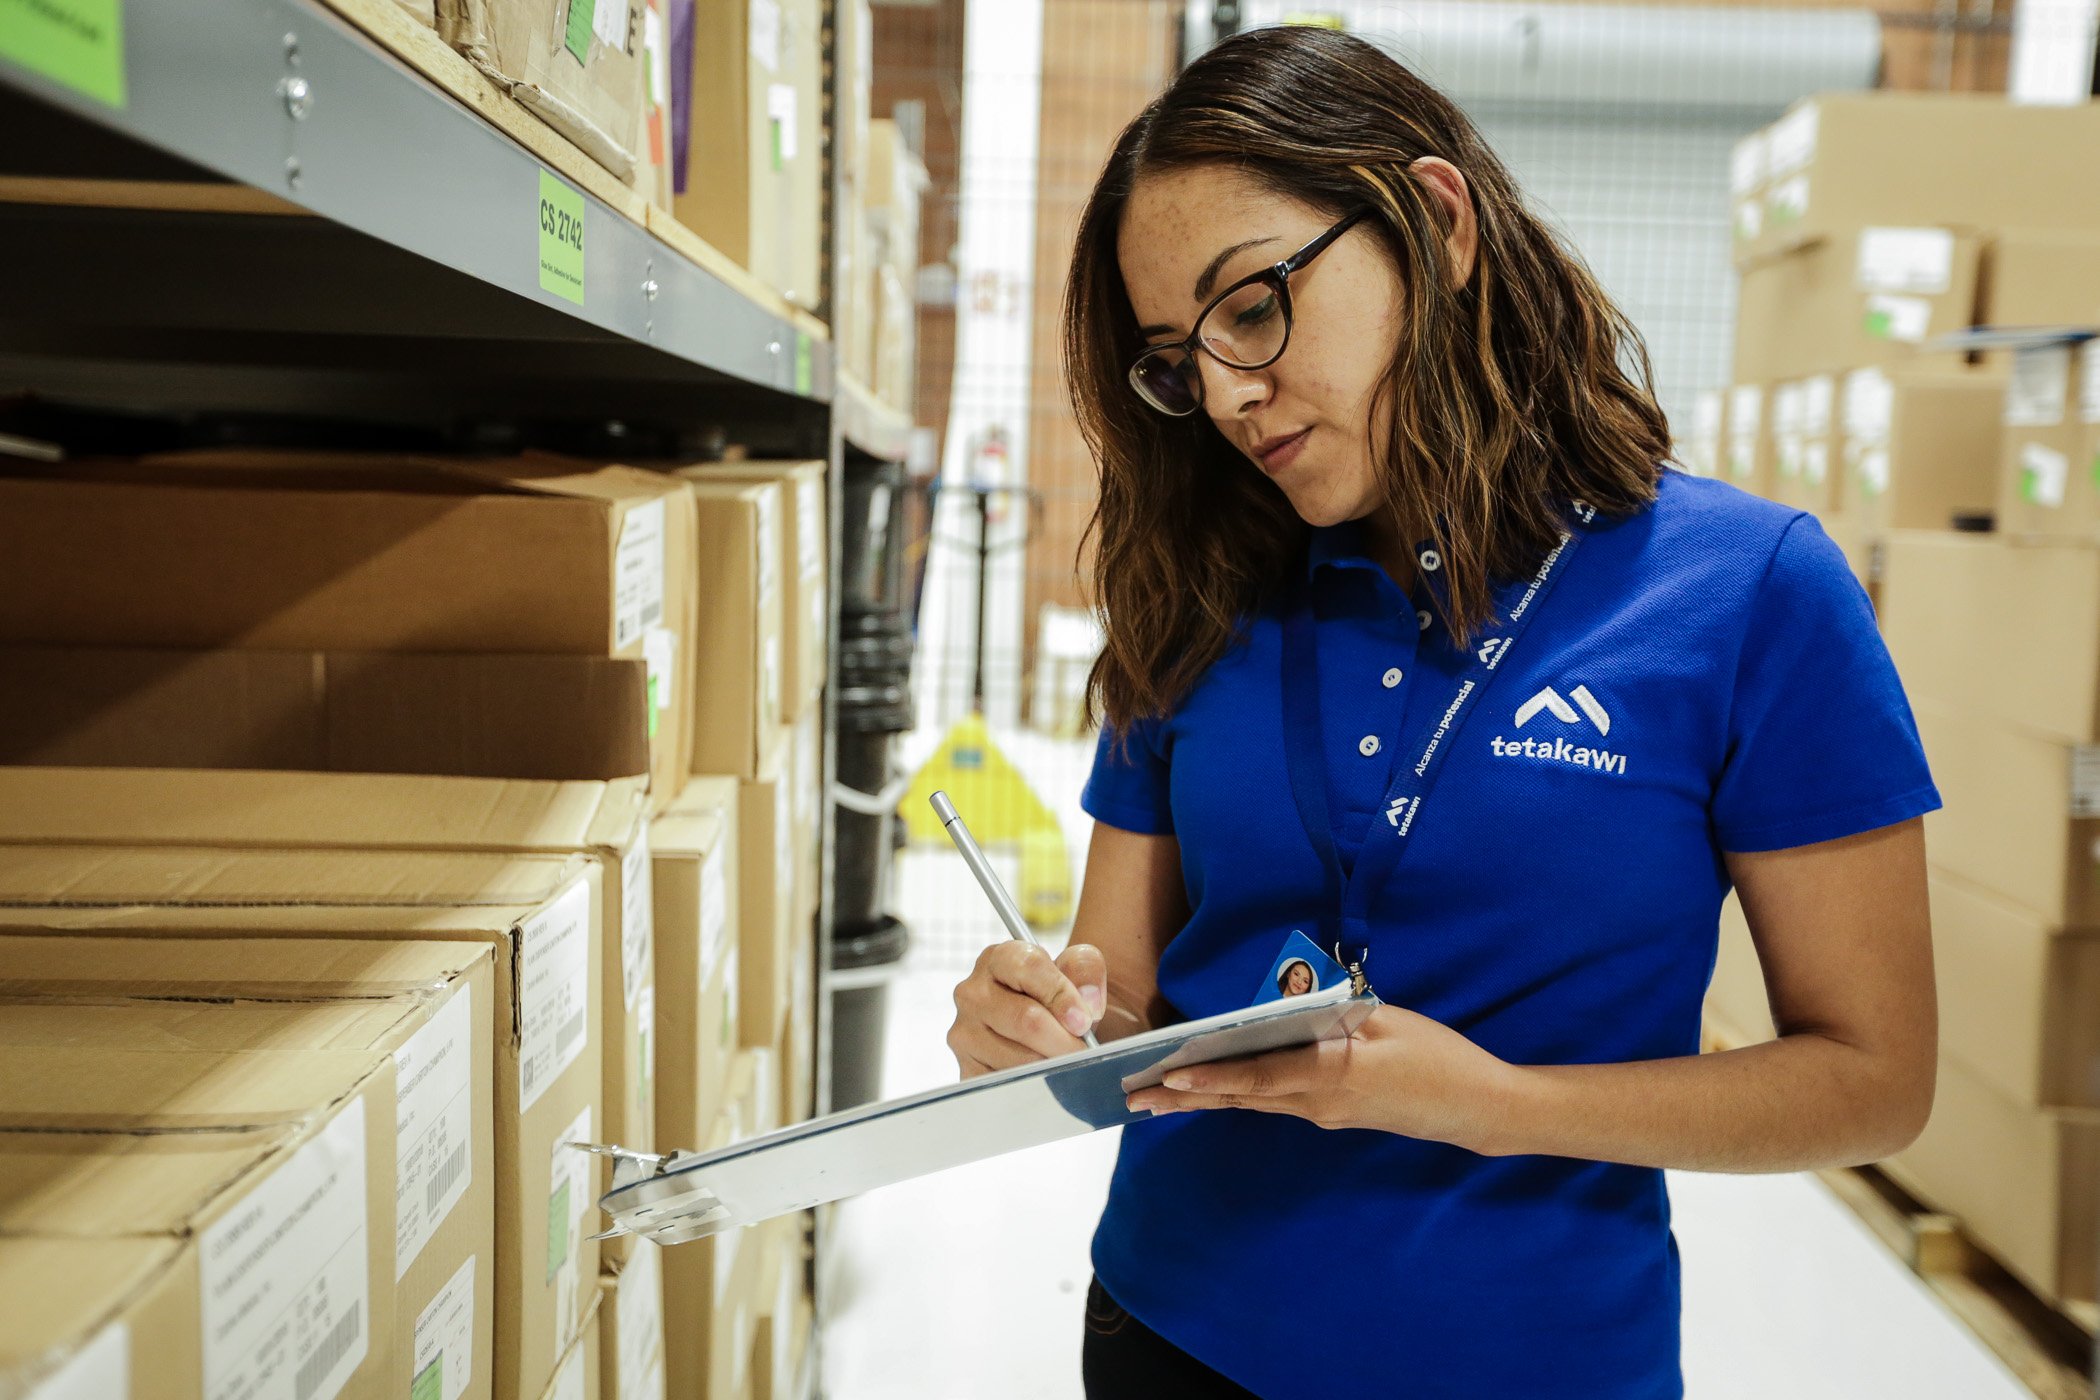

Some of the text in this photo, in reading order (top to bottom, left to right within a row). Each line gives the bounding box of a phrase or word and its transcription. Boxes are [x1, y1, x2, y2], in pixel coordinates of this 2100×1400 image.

[540, 198, 582, 251] CS 2742
[1509, 588, 1536, 622] Alcanza
[1530, 578, 1542, 589] tu
[1486, 637, 1513, 670] tetakawi
[1414, 680, 1475, 777] Alcanza tu potencial
[1490, 735, 1627, 775] tetakawi
[1397, 796, 1421, 837] tetakawi
